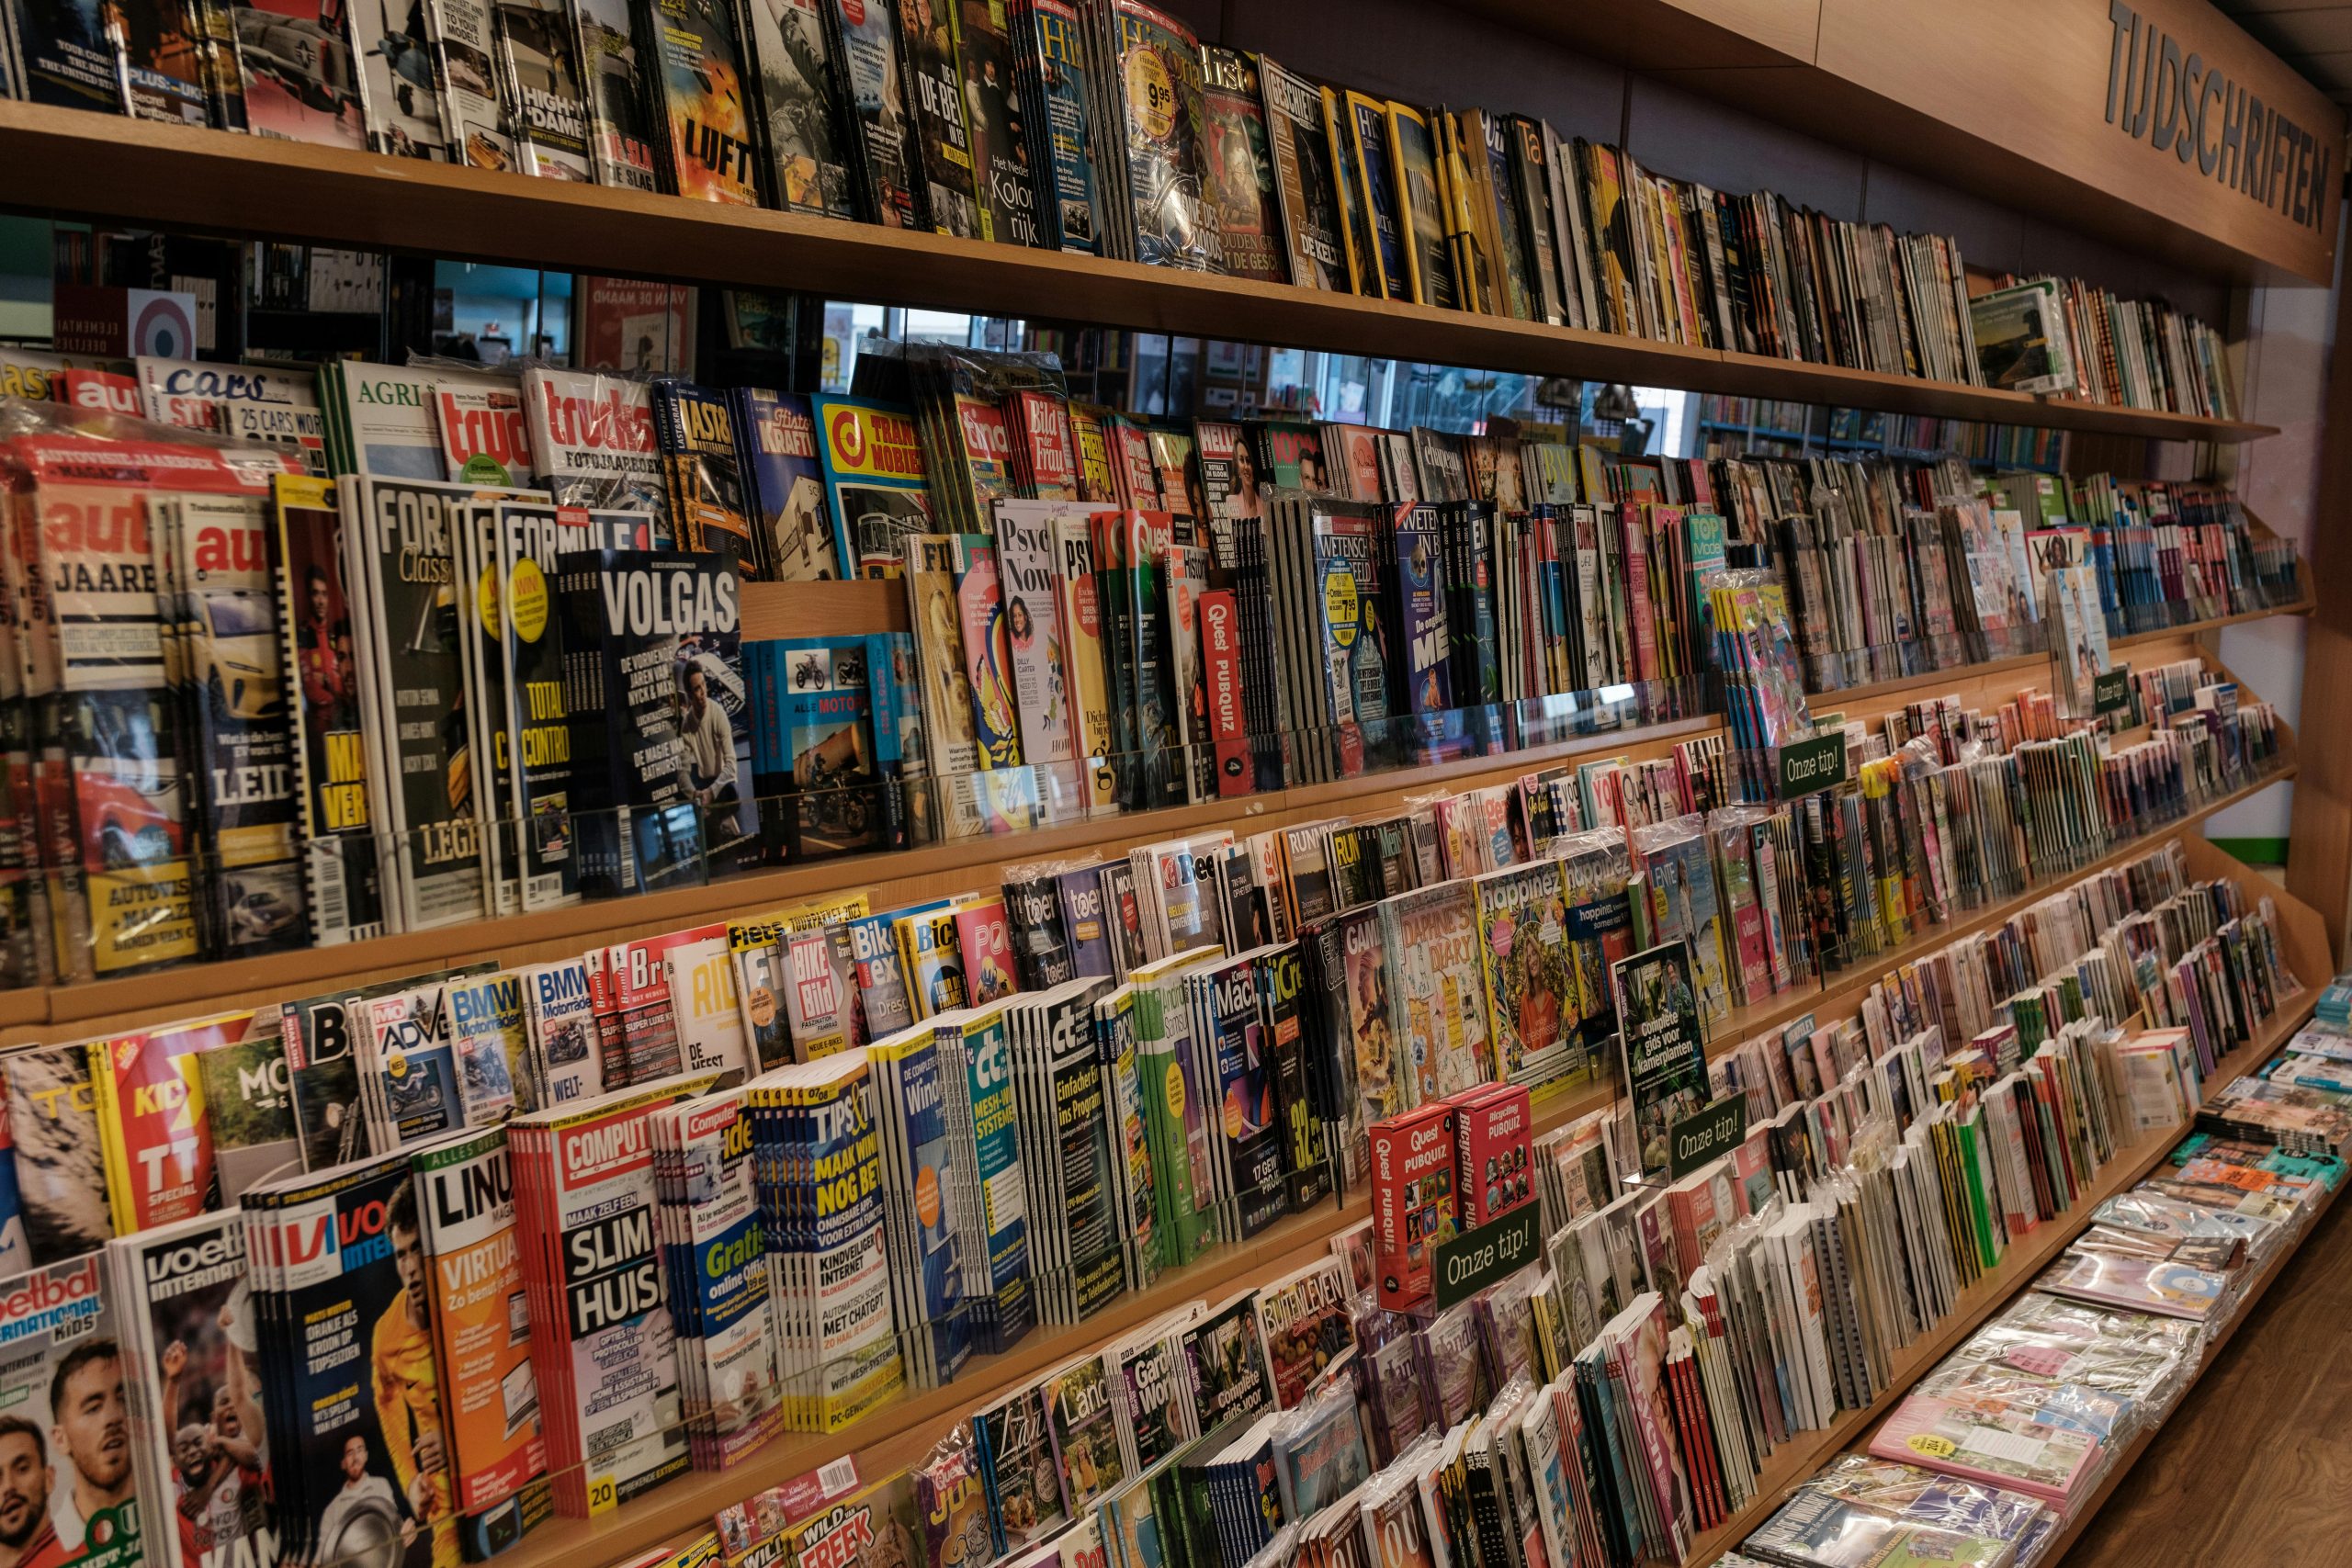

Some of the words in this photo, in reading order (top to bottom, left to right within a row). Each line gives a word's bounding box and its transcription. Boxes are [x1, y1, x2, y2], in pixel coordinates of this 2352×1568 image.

[918, 70, 941, 121] DE
[2106, 0, 2330, 235] TIJDSCHRIFTEN
[685, 118, 751, 184] LUFT
[1011, 212, 1040, 247] rijk
[162, 367, 267, 402] cars
[356, 379, 424, 412] AGRI
[259, 410, 294, 438] CARS
[543, 379, 656, 458] trucks
[672, 396, 687, 450] LAST&KRAFT
[680, 398, 733, 452] LAST&
[1027, 399, 1058, 438] Bild
[566, 450, 663, 476] FOTOJAARBOEK
[1035, 439, 1065, 479] Frau
[1133, 516, 1174, 559] Quest
[600, 570, 736, 637] VOLGAS
[1206, 603, 1230, 652] Quest
[1216, 658, 1236, 733] PUBQUIZ
[1787, 756, 1818, 787] Onze
[1818, 739, 1841, 775] tip!
[1480, 866, 1562, 915] happinez
[842, 903, 862, 924] 2023
[793, 939, 830, 981] BIKE
[452, 976, 518, 1032] BMW
[801, 977, 838, 1021] Bild
[1640, 1010, 1679, 1038] Complete
[1645, 1038, 1662, 1060] gids
[1662, 1026, 1680, 1044] voor
[687, 1042, 702, 1059] DE
[1637, 1039, 1694, 1079] kamerplanten
[553, 1075, 583, 1102] WELT-
[1056, 1066, 1090, 1103] Einfacher
[688, 1103, 737, 1136] Computer
[808, 1094, 853, 1145] TIPS
[1057, 1100, 1072, 1126] ins
[1488, 1102, 1519, 1122] Bicycling
[1488, 1115, 1521, 1139] PUBQUIZ
[1290, 1098, 1313, 1171] 32
[1410, 1122, 1439, 1153] Quest
[1458, 1111, 1474, 1195] Bicycling
[1679, 1129, 1713, 1160] Onze
[1714, 1108, 1738, 1146] tip!
[138, 1135, 200, 1193] TT
[814, 1144, 855, 1183] MAAK
[1374, 1137, 1393, 1182] Quest
[1404, 1144, 1447, 1174] PUBQUIZ
[148, 1184, 199, 1207] SPECIAL
[566, 1208, 598, 1227] MAAK
[599, 1201, 620, 1217] ZELF
[620, 1193, 638, 1211] EEN
[816, 1168, 859, 1218] NOG
[819, 1226, 843, 1249] VOOR
[1381, 1188, 1395, 1254] PUBQUIZ
[571, 1209, 653, 1279] SLIM
[706, 1221, 765, 1280] Gratis
[820, 1232, 876, 1271] KINDVEILIGER
[1447, 1242, 1494, 1287] Onze
[1498, 1218, 1530, 1261] tip!
[708, 1274, 743, 1301] online
[820, 1256, 864, 1287] INTERNET
[447, 1293, 467, 1313] Zo
[575, 1269, 663, 1335] HUIS
[823, 1314, 848, 1337] MET
[848, 1291, 885, 1325] CHATGPT
[1261, 1268, 1344, 1339] BUITENLEVEN
[54, 1313, 96, 1341] KIDS
[599, 1329, 626, 1347] OPTIES
[625, 1325, 637, 1337] EN
[592, 1334, 645, 1362] PROTOCOLLEN
[590, 1384, 614, 1404] HOME
[614, 1370, 653, 1393] ASSISTANT
[602, 1362, 641, 1388] INSTALLEER
[1216, 1368, 1261, 1409] Complete
[584, 1404, 596, 1417] OP
[596, 1398, 610, 1413] EEN
[610, 1383, 650, 1408] RASPBERRY
[1241, 1388, 1262, 1409] voor
[591, 1483, 612, 1508] 20
[787, 1479, 809, 1497] Kinder
[799, 1510, 875, 1568] FREEK
[802, 1506, 845, 1545] WILD
